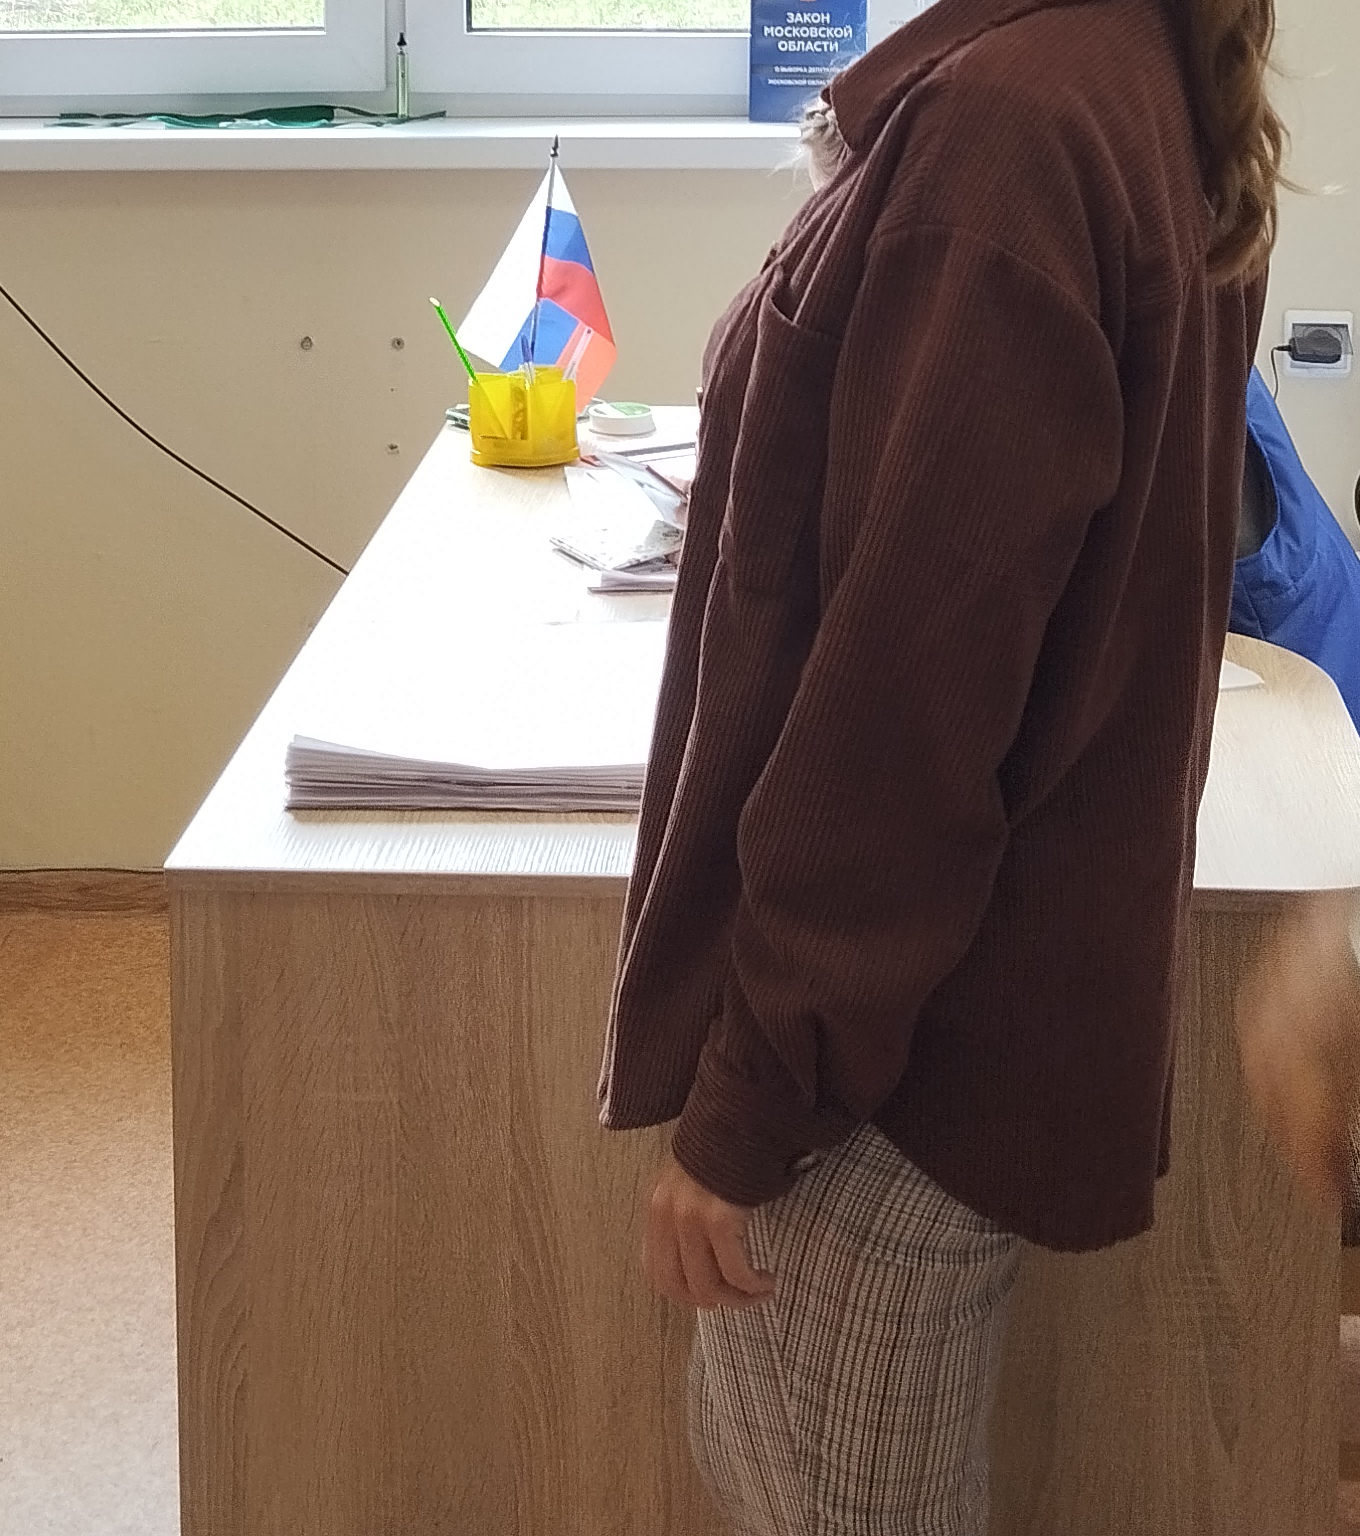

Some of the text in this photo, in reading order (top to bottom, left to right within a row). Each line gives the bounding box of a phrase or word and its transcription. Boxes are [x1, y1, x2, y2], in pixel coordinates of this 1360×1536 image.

[786, 12, 830, 24] ЗАКОН
[763, 24, 853, 39] МОСКОВСКОЙ
[777, 40, 839, 53] ОБЛАСТИ
